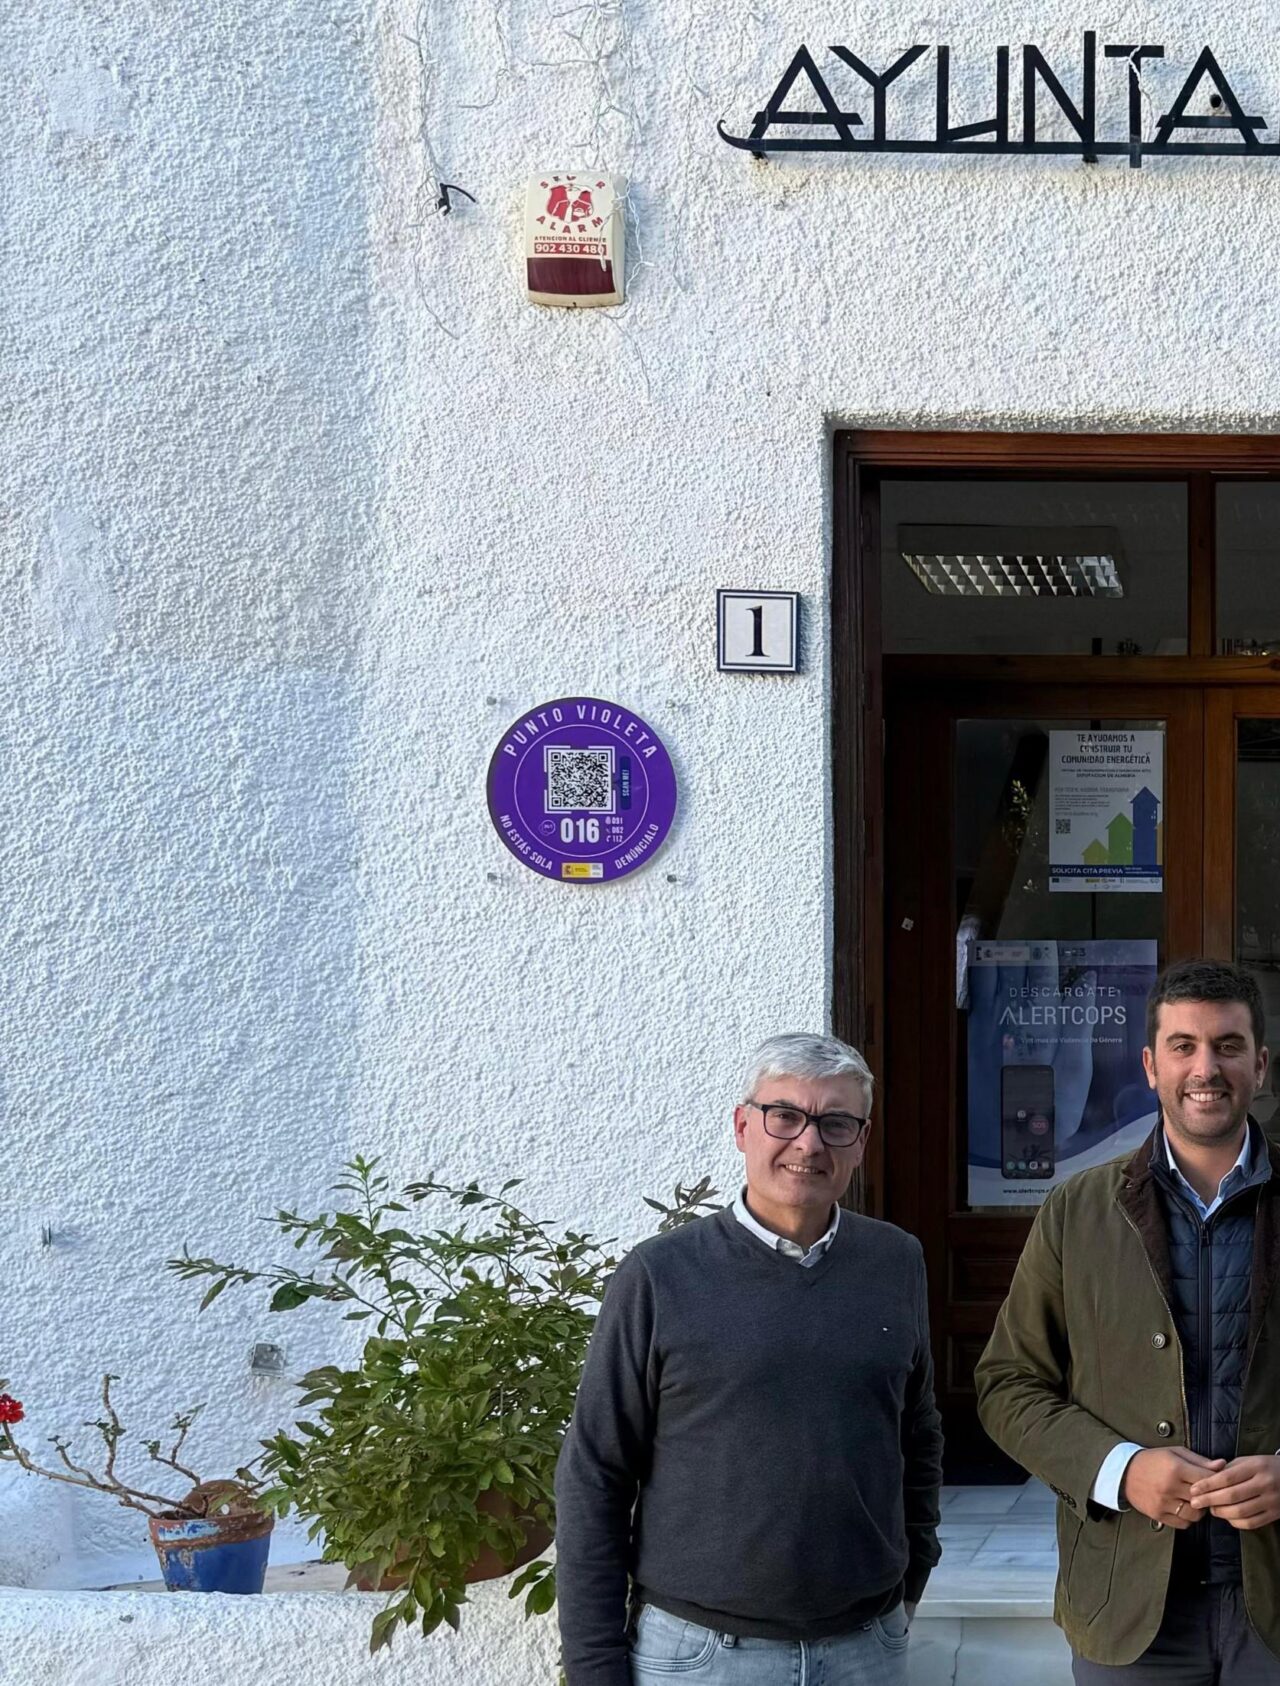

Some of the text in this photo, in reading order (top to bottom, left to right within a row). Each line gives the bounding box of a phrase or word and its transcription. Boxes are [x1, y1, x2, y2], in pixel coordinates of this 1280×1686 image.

[536, 216, 603, 234] ALARM
[536, 244, 604, 254] 902 430 480
[745, 605, 770, 658] 1
[504, 705, 657, 759] PUNTO VIOLETA
[1088, 734, 1128, 743] AYUDAMOS
[1062, 754, 1150, 764] COMUNIDAD ENERGÉTICA
[560, 818, 599, 843] 016
[500, 814, 512, 828] NO
[508, 829, 531, 855] ESTÁS
[530, 852, 552, 870] SOLA
[615, 823, 658, 869] DENÚNCIALO
[1000, 1006, 1126, 1025] ALERTCOPS
